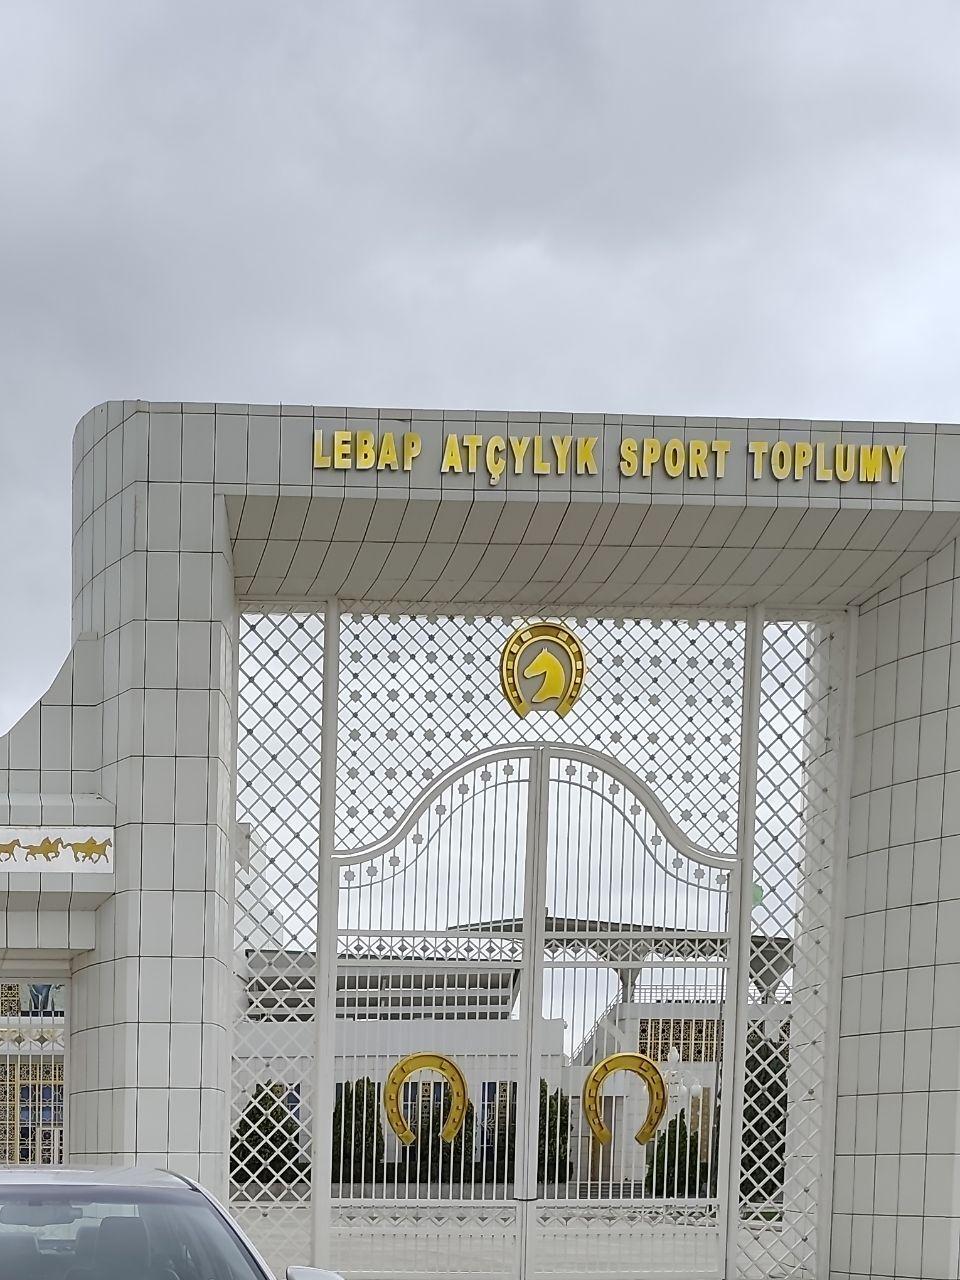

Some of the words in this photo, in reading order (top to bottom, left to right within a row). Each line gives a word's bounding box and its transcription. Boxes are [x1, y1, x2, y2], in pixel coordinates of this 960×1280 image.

[313, 429, 422, 472] LEBAP
[441, 433, 599, 486] ATÇYLYK
[619, 437, 731, 479] SPORT
[748, 440, 908, 484] TOPLUMY
